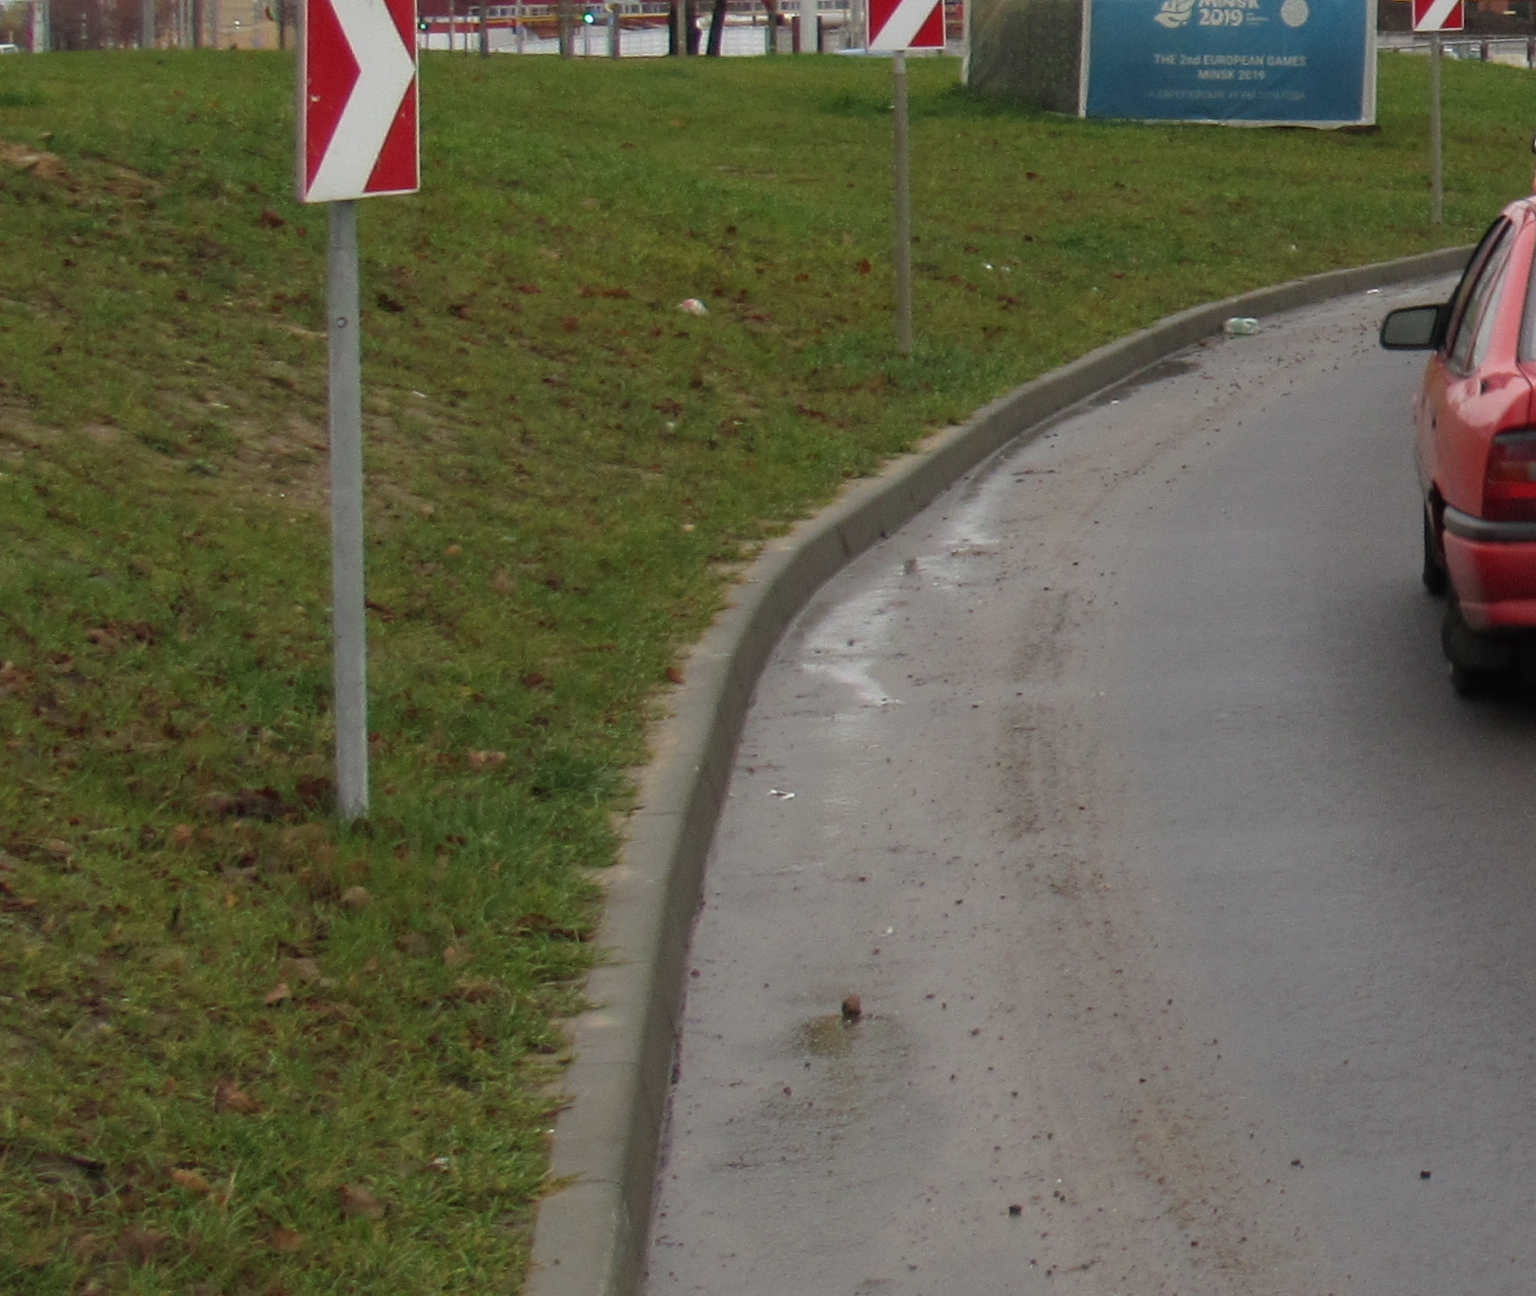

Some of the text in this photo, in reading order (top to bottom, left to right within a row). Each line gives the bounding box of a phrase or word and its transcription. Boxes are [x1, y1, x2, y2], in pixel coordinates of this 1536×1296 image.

[1199, 8, 1243, 26] 2019
[1154, 55, 1306, 66] THE 2nd EUROPEAN GAMES
[1198, 70, 1265, 80] MINSK 2019
